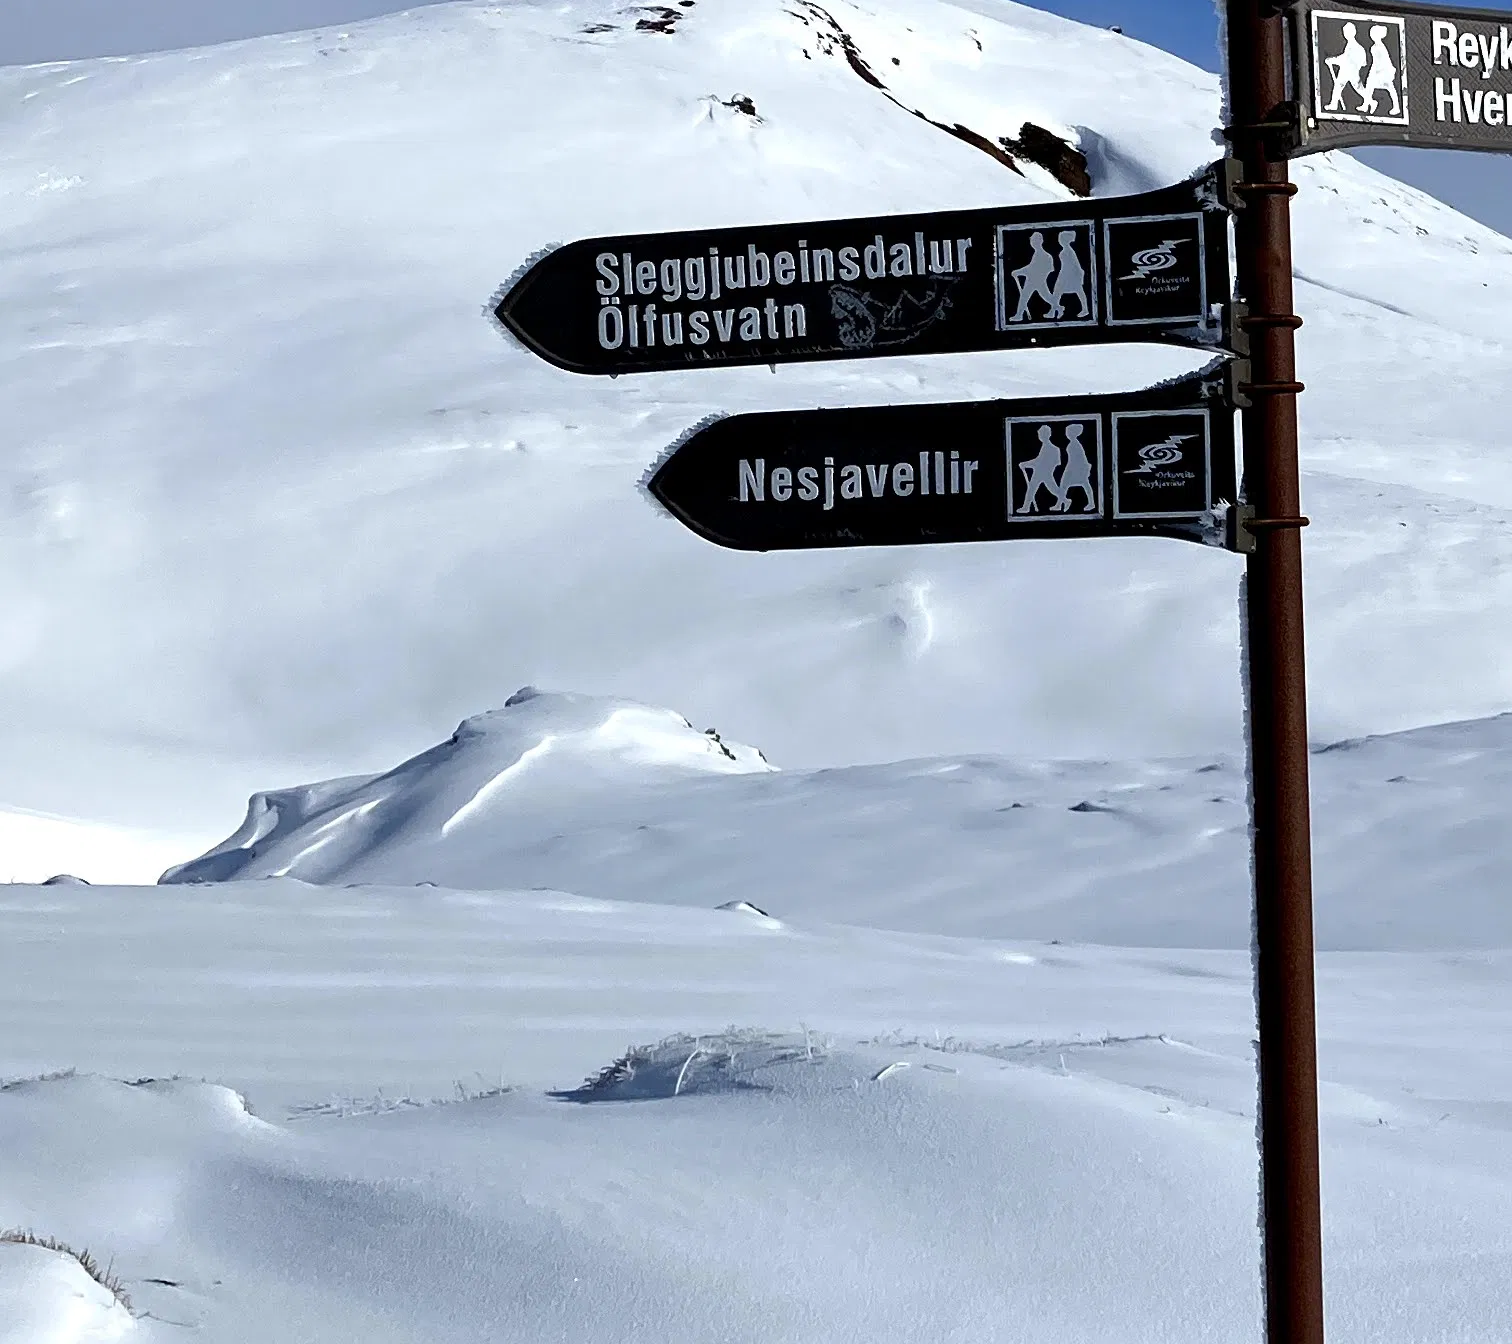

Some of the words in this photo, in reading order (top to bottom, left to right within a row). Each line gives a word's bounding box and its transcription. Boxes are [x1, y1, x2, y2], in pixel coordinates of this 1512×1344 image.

[595, 231, 972, 301] Sleggjubeinsdalur
[598, 297, 807, 350] Ölfusvatn
[738, 450, 979, 511] Nesjavellir
